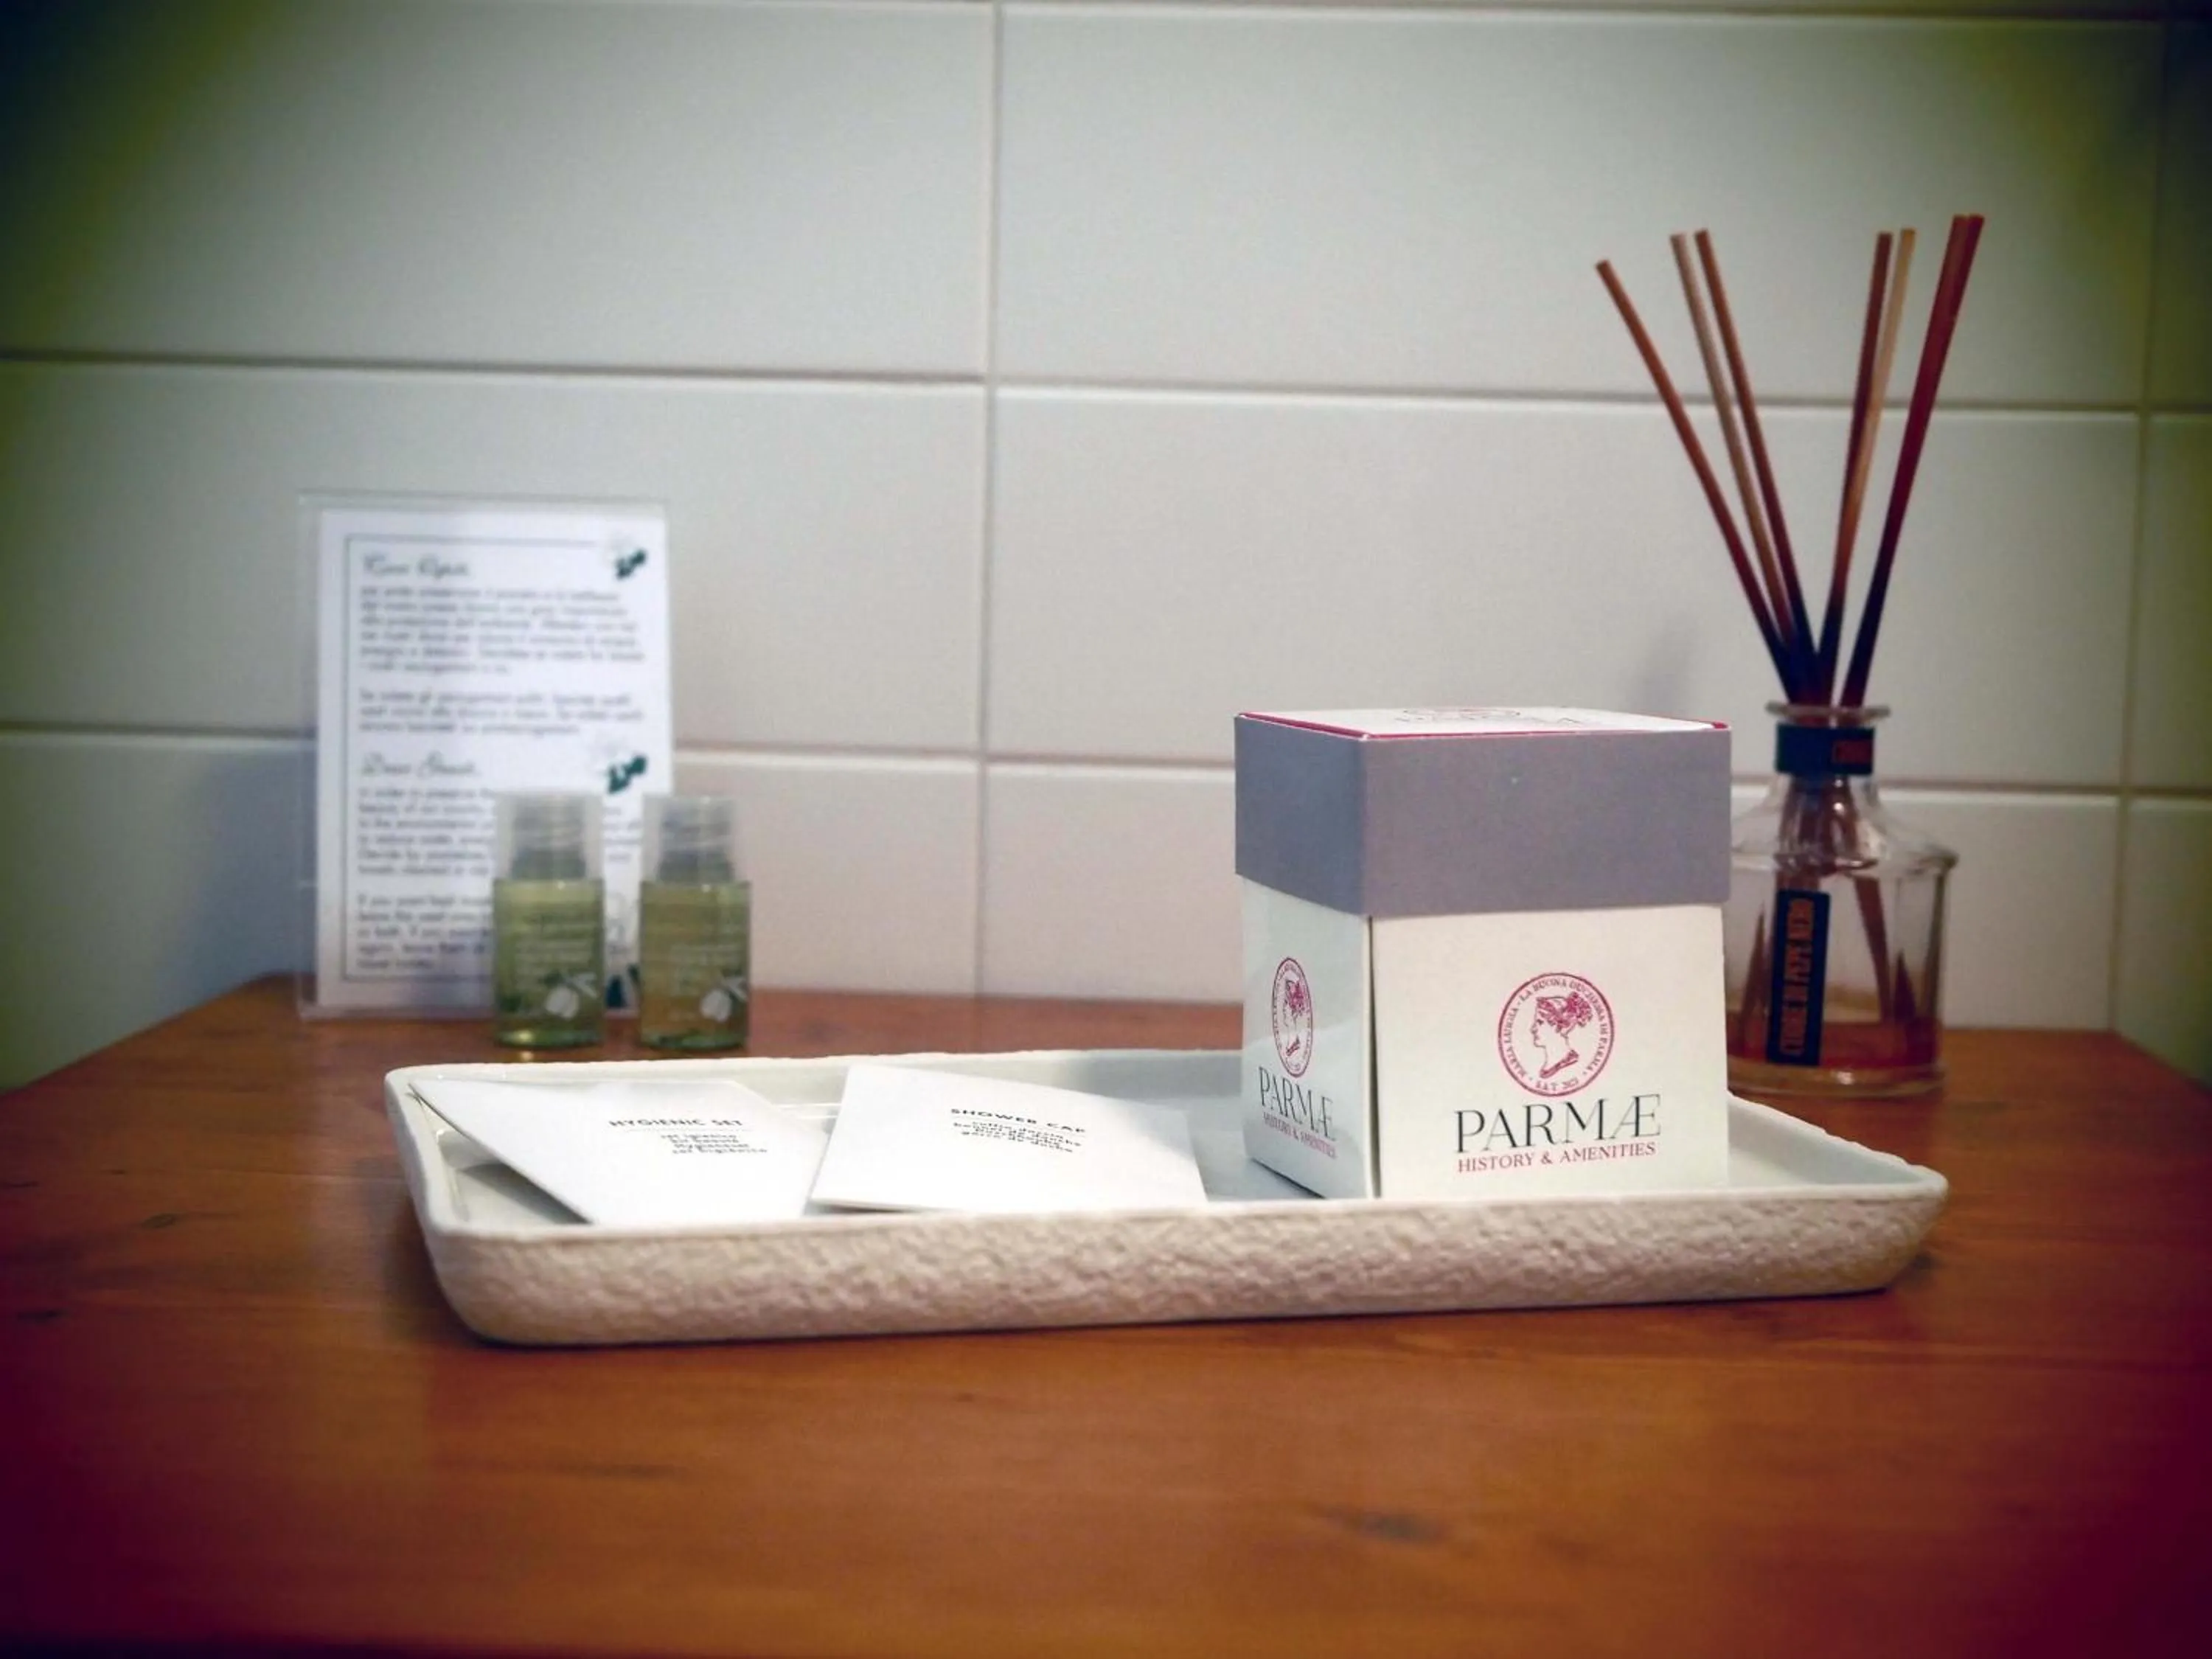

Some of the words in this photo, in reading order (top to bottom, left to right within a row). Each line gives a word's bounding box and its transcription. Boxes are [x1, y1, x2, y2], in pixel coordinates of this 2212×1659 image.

[609, 1119, 706, 1127] HYGIENIC
[712, 1119, 743, 1127] SET
[950, 1107, 1037, 1124] SHOWER
[1046, 1122, 1086, 1133] CAP
[1457, 1152, 1535, 1173] HISTORY
[1540, 1152, 1554, 1166] &
[1559, 1141, 1658, 1164] AMENITIES
